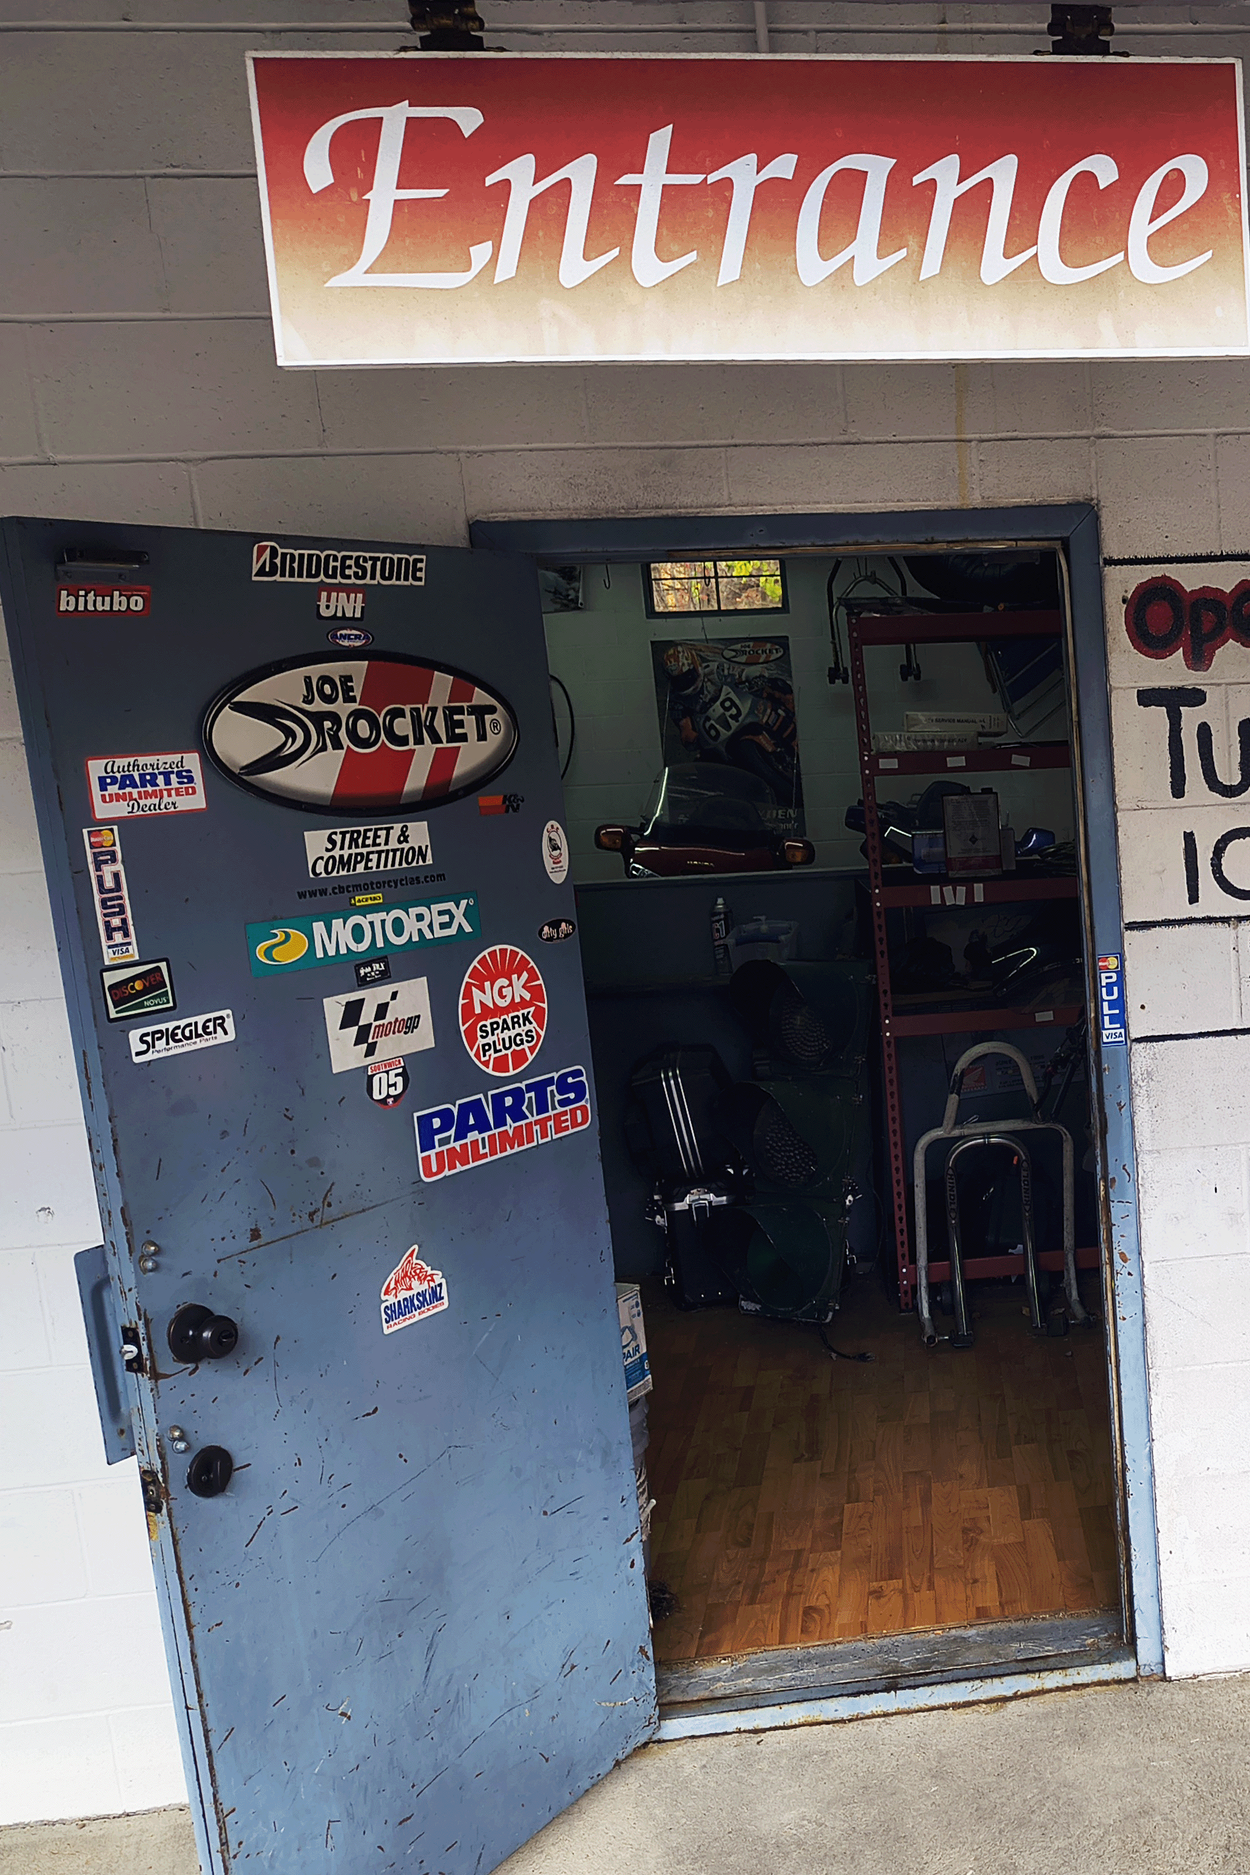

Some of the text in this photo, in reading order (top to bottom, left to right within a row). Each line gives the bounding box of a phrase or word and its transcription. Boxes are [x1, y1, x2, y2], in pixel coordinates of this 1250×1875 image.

[302, 99, 1214, 290] Entrance
[252, 544, 424, 582] BRIDGESTONE
[59, 589, 145, 613] bitubo
[318, 591, 364, 618] UNI
[302, 674, 357, 706] JOE
[104, 756, 186, 775] Authorized
[98, 768, 196, 793] PARTS
[100, 785, 198, 804] UNLIMITED
[127, 797, 179, 815] Dealer
[324, 824, 410, 852] STREET &
[310, 845, 429, 878] COMPETITION
[92, 849, 131, 942] PUSH
[111, 946, 130, 957] VISA
[111, 971, 164, 1001] DISCOVER
[471, 970, 532, 1014] NGK
[144, 996, 168, 1007] NOVUS
[1100, 972, 1121, 1029] PULL
[372, 1014, 421, 1041] motogp
[478, 1010, 534, 1040] SPARK
[1104, 1031, 1124, 1040] VISA
[151, 1040, 198, 1055] Performance
[481, 1030, 535, 1058] PLUGS
[372, 1068, 404, 1101] 05
[416, 1069, 587, 1154] PARTS
[420, 1104, 590, 1179] UNLIMITED
[383, 1282, 445, 1324] SHARKSKINZ
[386, 1313, 416, 1330] RACING
